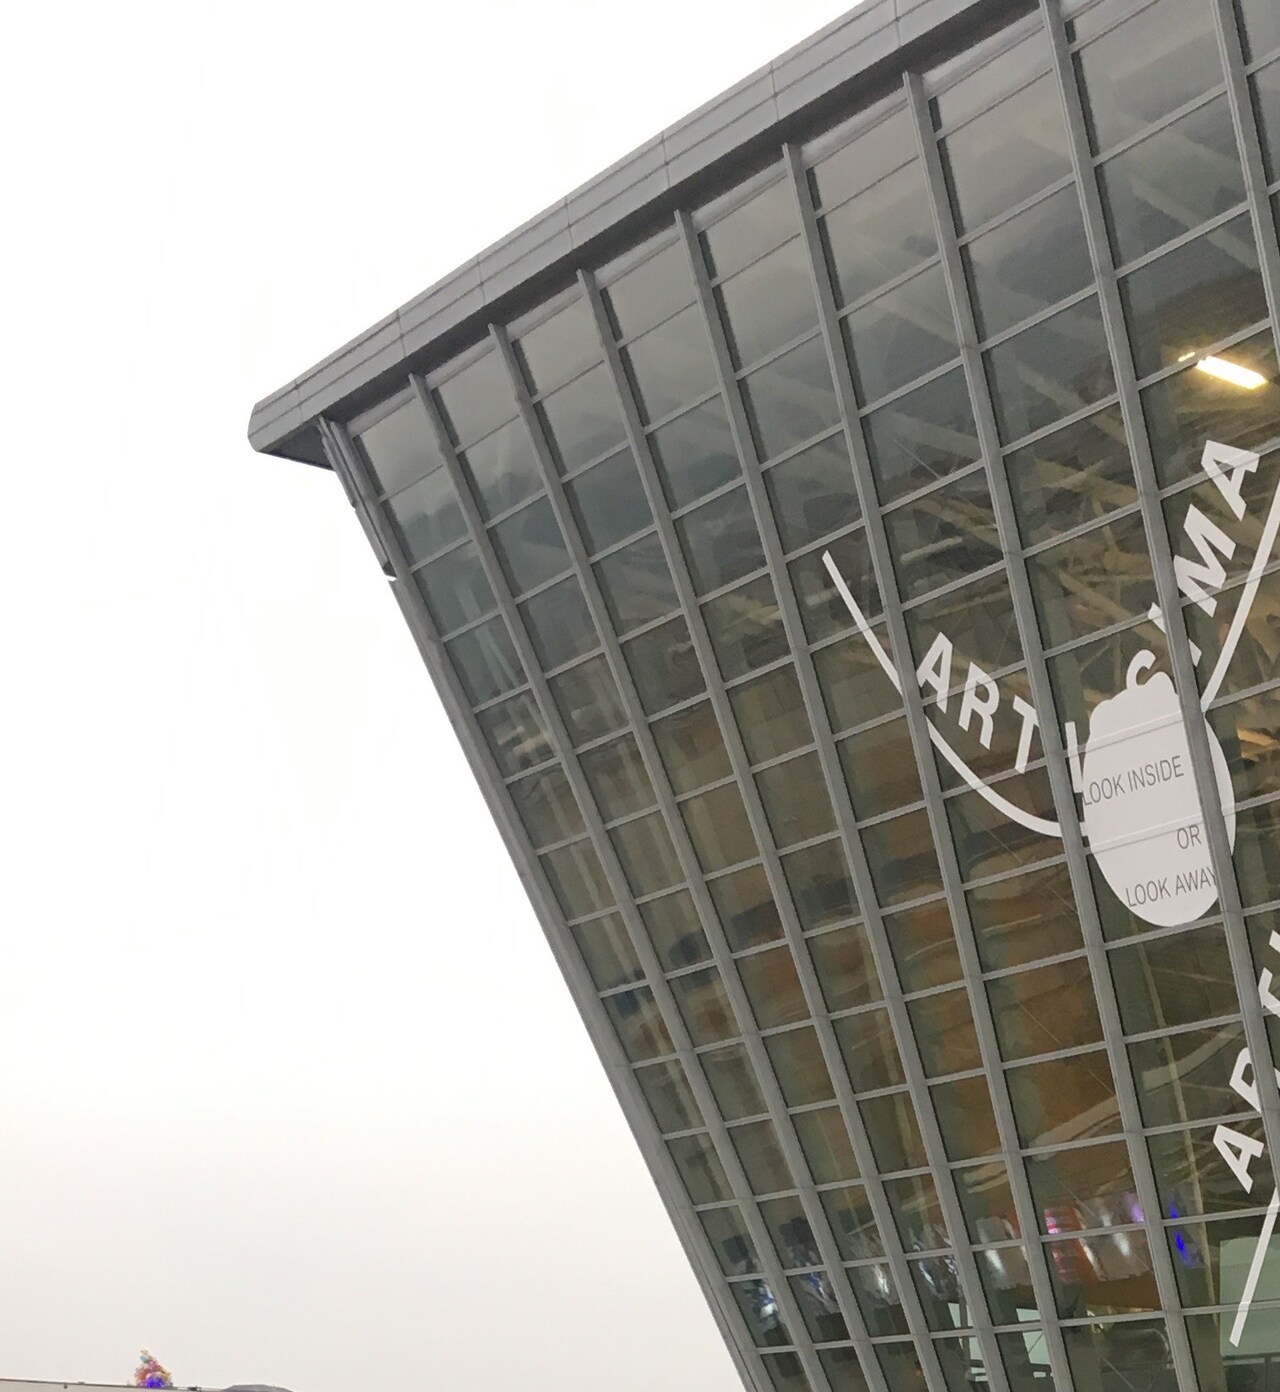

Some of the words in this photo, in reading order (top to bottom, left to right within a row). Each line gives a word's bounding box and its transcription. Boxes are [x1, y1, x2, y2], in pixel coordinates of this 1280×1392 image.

[917, 440, 1260, 793] ARTISMA
[1082, 774, 1126, 806] LOOK
[1127, 755, 1185, 792] INSIDE
[1177, 824, 1202, 850] OR
[1126, 877, 1171, 907] LOOK
[1175, 866, 1217, 896] AWAY
